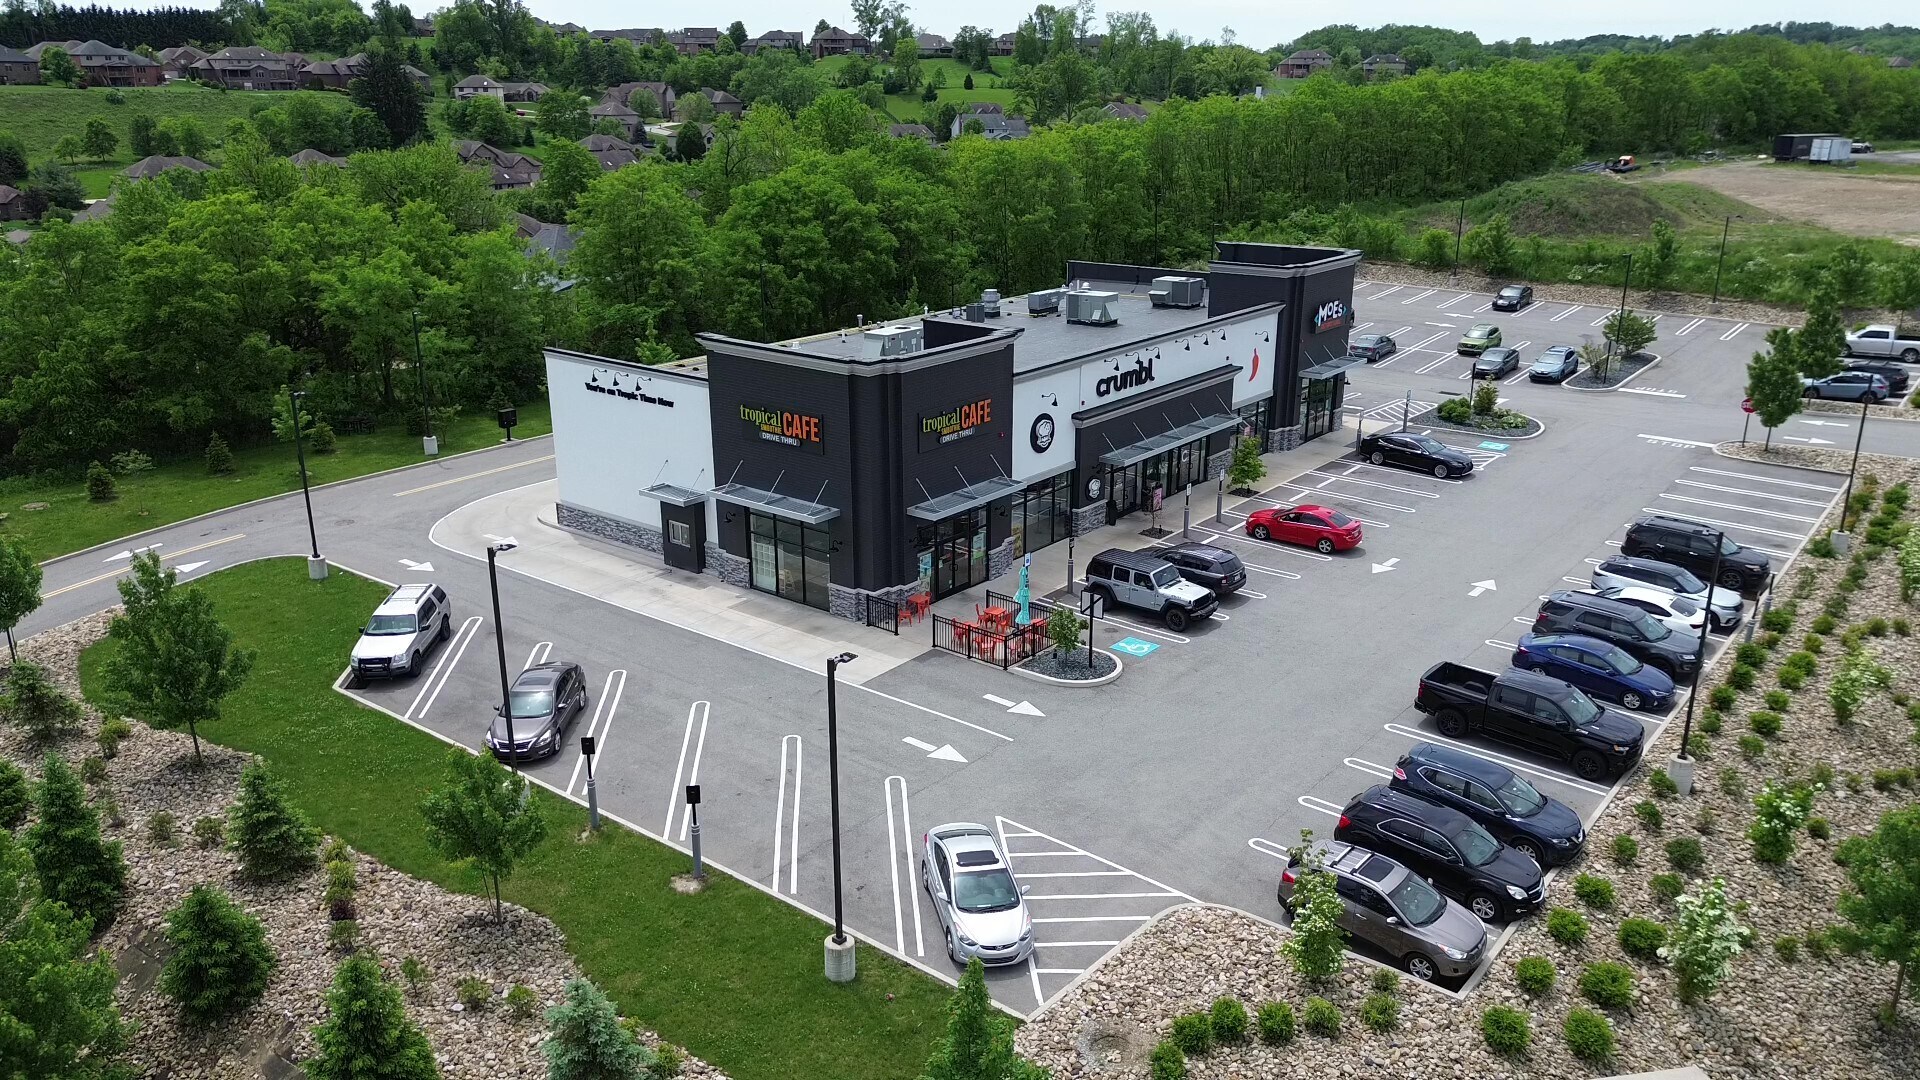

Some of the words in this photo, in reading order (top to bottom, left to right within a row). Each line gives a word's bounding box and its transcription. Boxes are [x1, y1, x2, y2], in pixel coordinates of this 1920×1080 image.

[1096, 358, 1155, 397] crumbl
[585, 382, 606, 393] You're
[606, 388, 616, 396] on
[616, 388, 639, 401] Tropic
[639, 393, 657, 404] Time
[657, 397, 675, 408] Now
[740, 404, 781, 427] tropical
[783, 412, 820, 442] CAFE
[923, 408, 960, 433] tropical
[961, 399, 992, 429] CAFE
[762, 432, 780, 441] DRIVE
[781, 436, 797, 446] THRU
[942, 432, 958, 443] DRIVE
[959, 428, 973, 438] THRU
